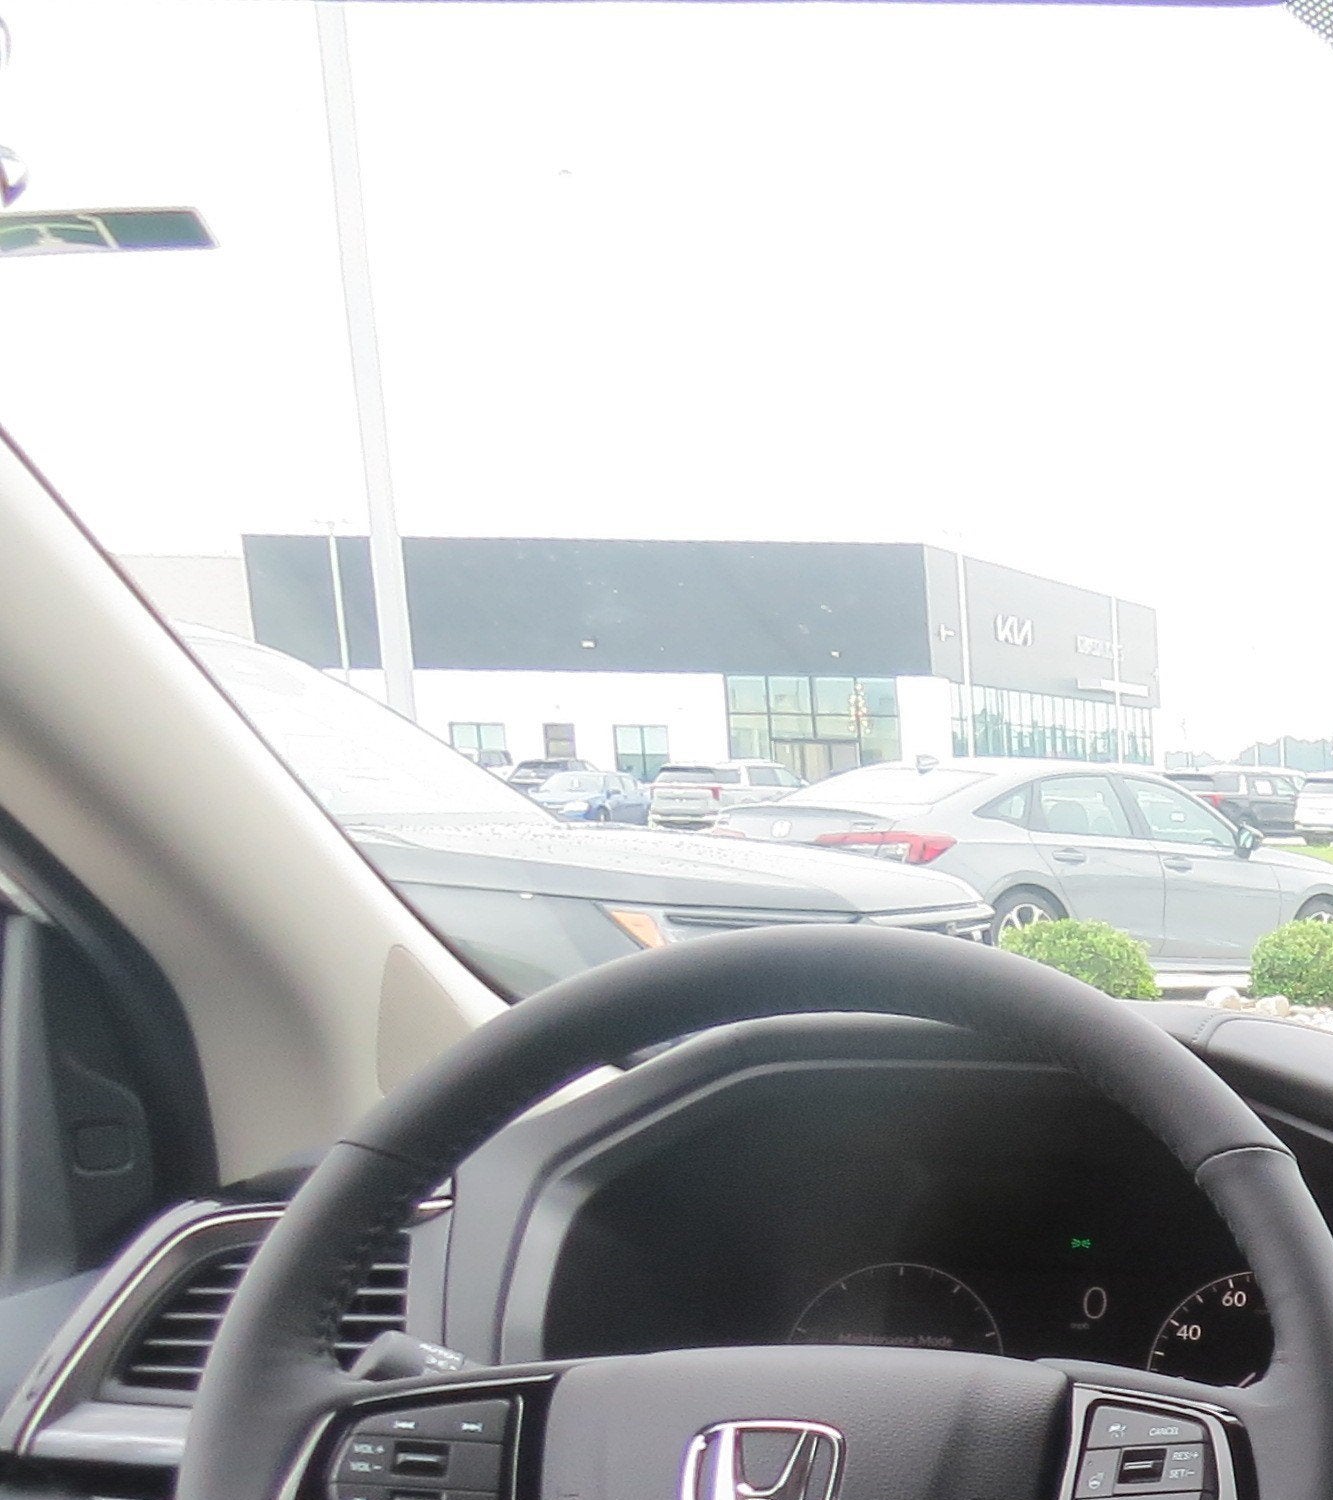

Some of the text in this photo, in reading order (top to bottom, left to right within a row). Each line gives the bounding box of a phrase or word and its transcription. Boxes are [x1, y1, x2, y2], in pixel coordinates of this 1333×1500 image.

[1083, 1286, 1107, 1319] 0
[1221, 1290, 1248, 1308] 60
[1175, 1324, 1201, 1341] 40
[1149, 1426, 1179, 1436] CANCEL
